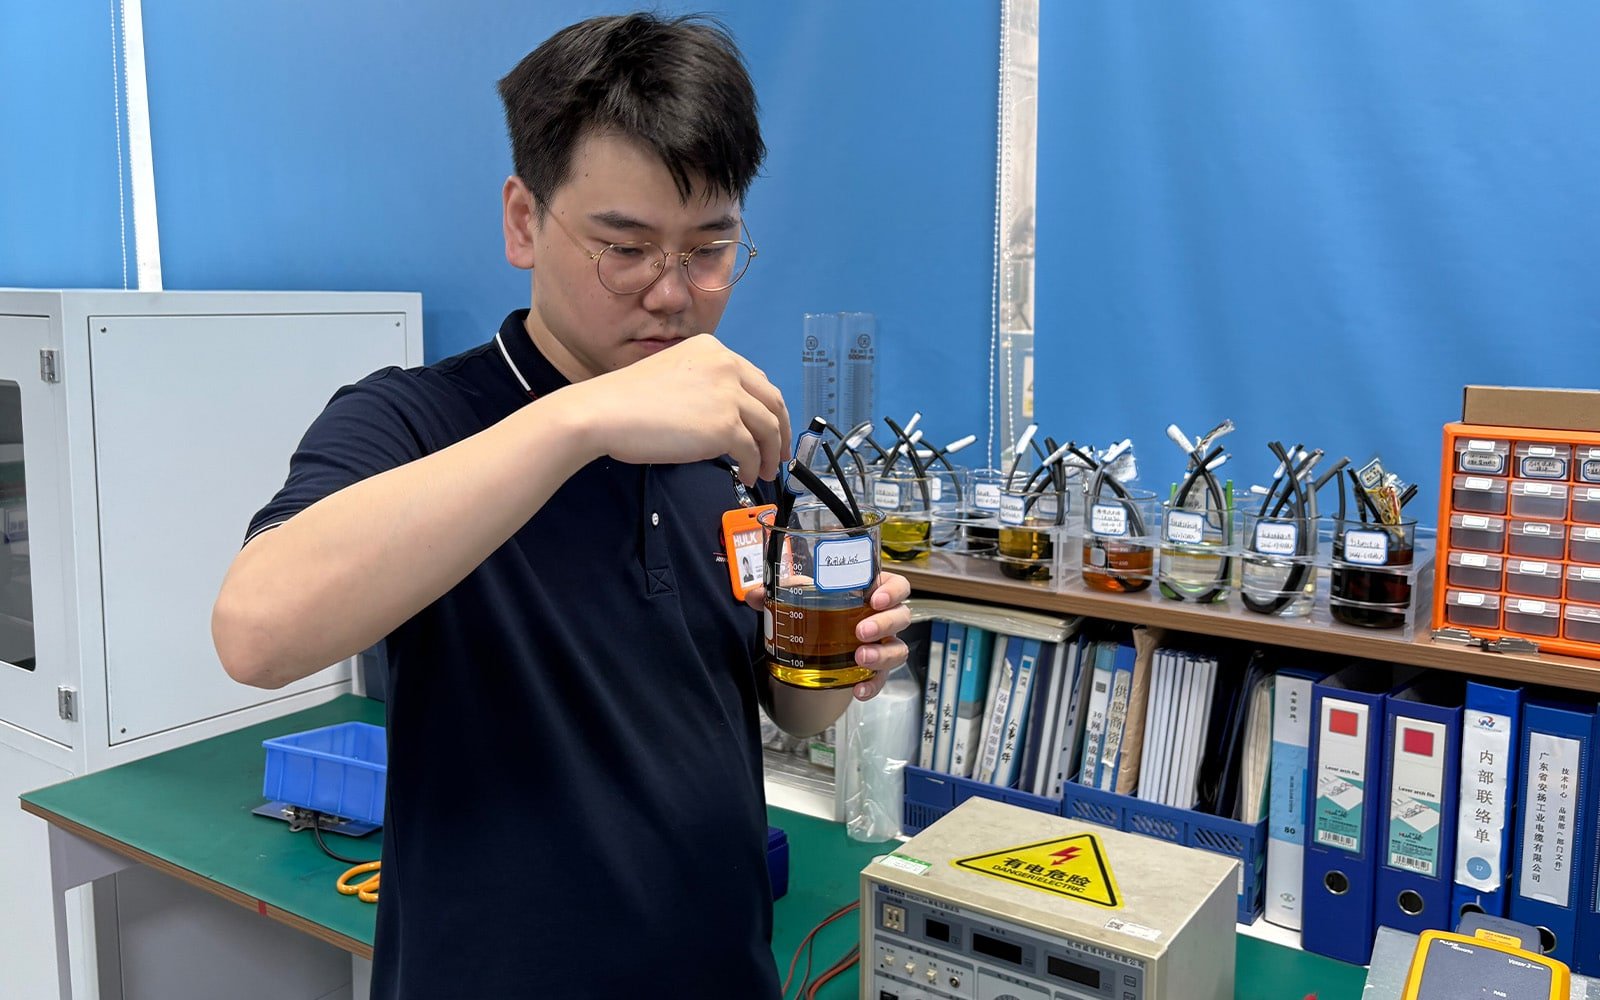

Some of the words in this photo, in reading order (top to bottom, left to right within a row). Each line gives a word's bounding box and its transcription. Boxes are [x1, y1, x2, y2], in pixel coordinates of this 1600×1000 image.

[733, 532, 757, 546] HULK
[789, 611, 804, 619] 300
[789, 635, 804, 643] 200
[790, 659, 804, 667] 100
[1325, 765, 1339, 773] Lever
[1559, 767, 1570, 799] 技术中心
[1473, 750, 1494, 844] 内部联络单
[1283, 826, 1296, 835] 80
[1003, 857, 1092, 888] 有电危险
